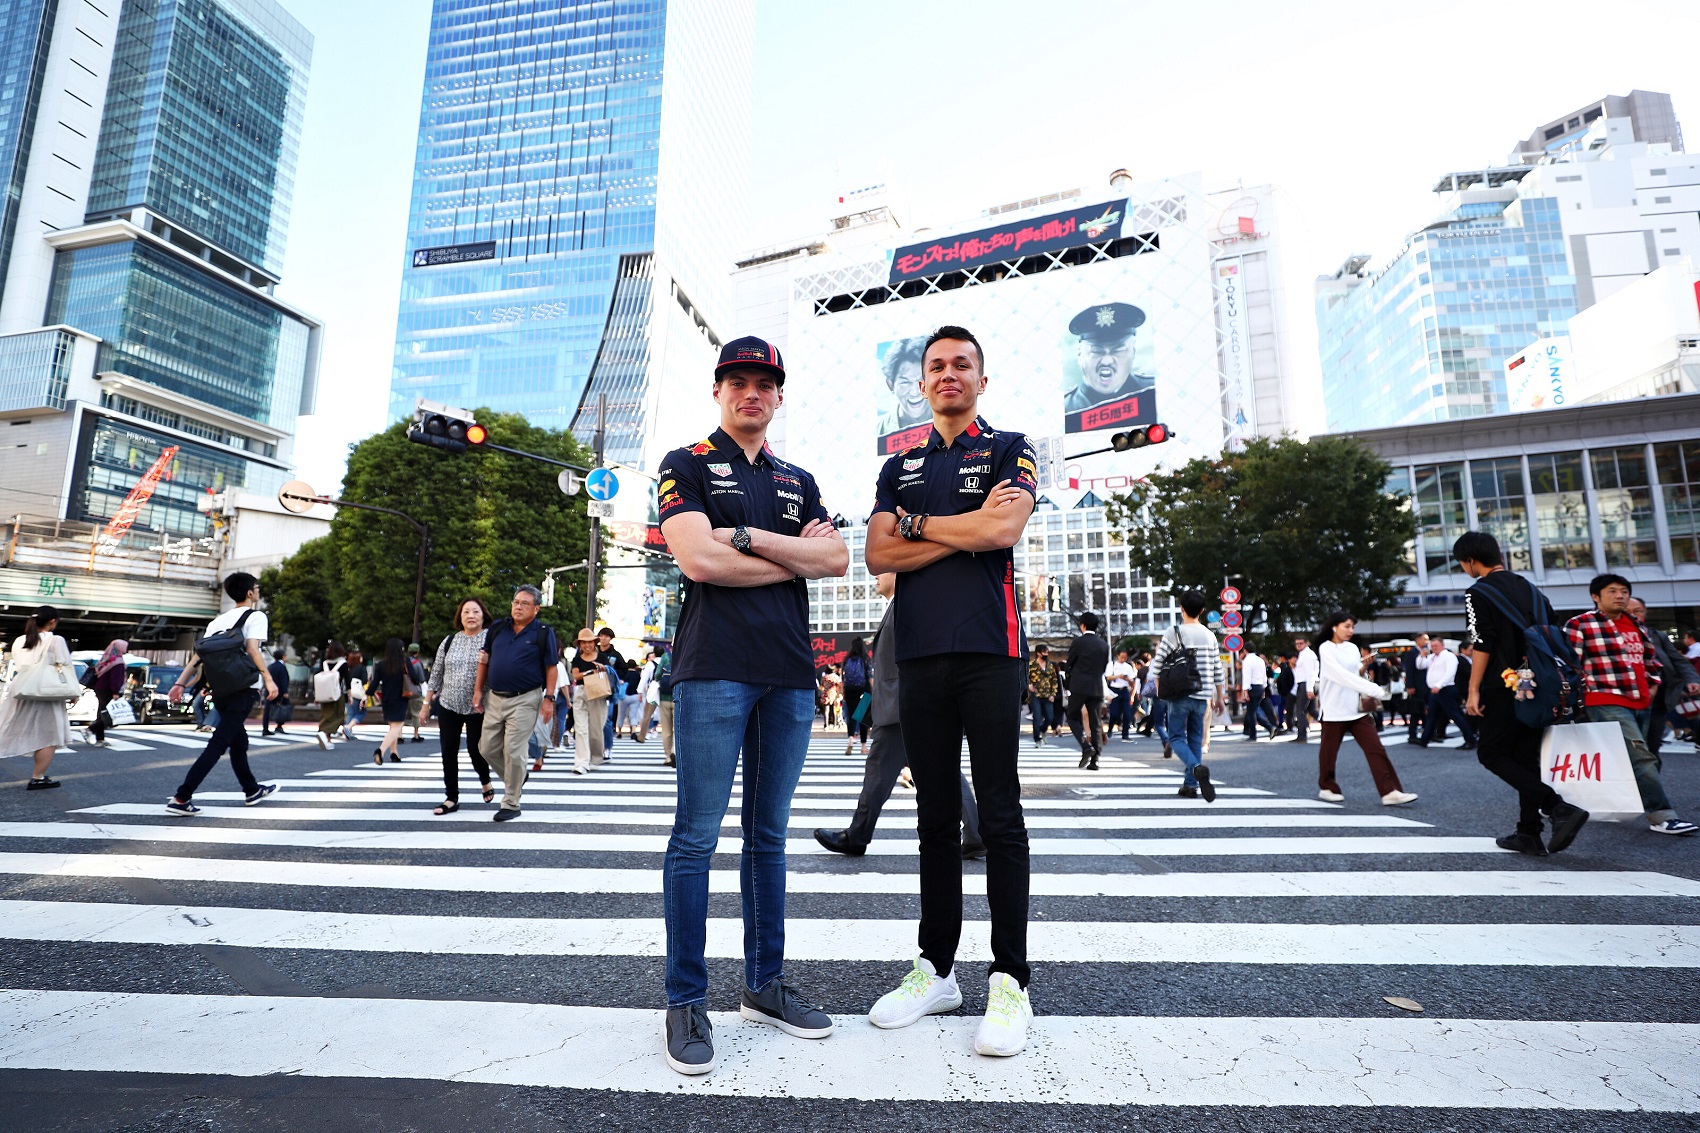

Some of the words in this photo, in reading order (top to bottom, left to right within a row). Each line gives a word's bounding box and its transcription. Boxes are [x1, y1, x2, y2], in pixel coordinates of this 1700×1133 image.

[428, 253, 464, 264] SCRAMBLE
[465, 249, 493, 260] SQUARE
[429, 248, 459, 257] SHIBUYA
[1225, 277, 1238, 318] TOKYU
[1087, 402, 1135, 426] #6周年
[959, 465, 981, 475] Mobil
[669, 498, 684, 508] Bull
[38, 576, 66, 596] 駅
[1550, 752, 1601, 782] H&M
